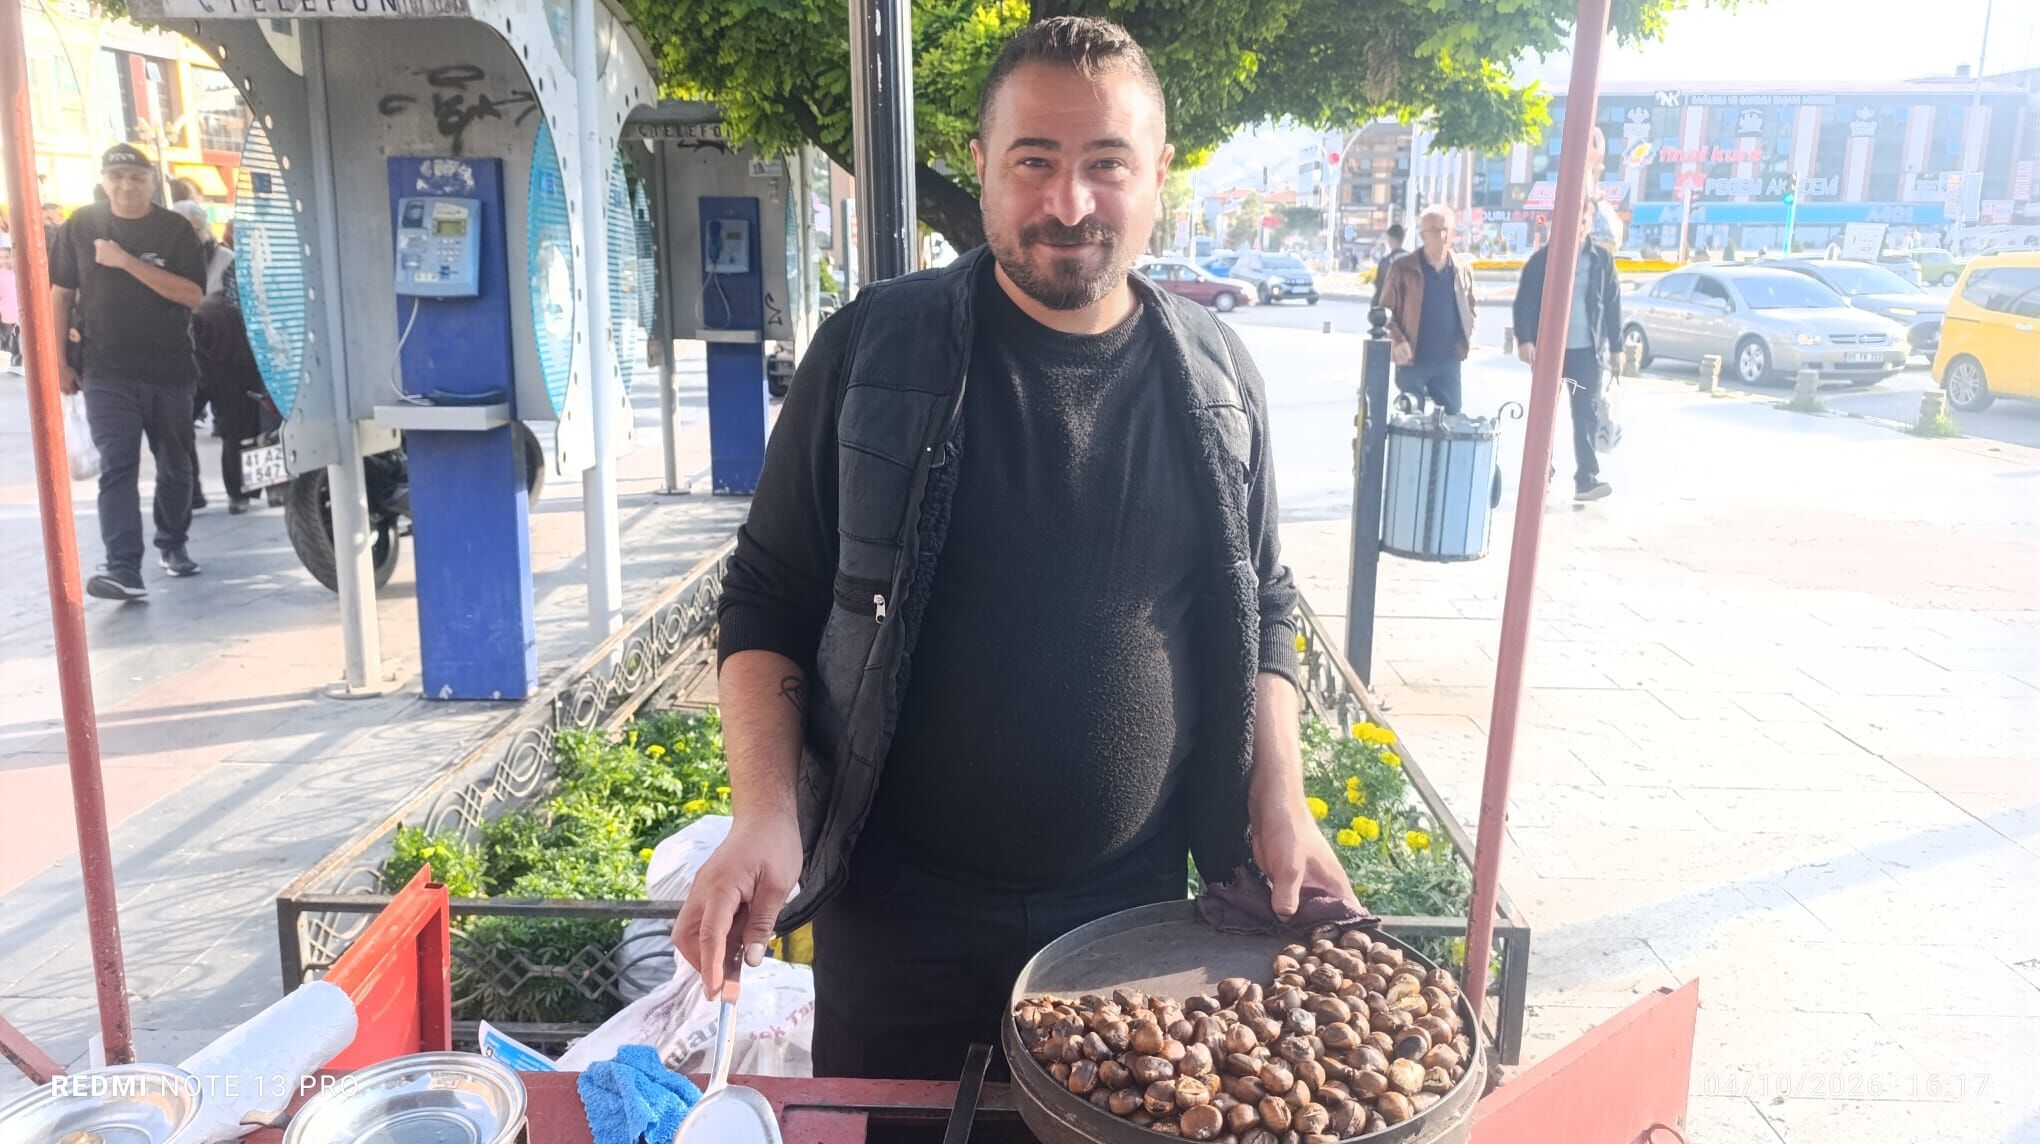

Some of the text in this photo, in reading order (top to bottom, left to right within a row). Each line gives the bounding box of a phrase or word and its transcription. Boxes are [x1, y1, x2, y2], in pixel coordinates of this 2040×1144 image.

[651, 125, 731, 138] TELEFO
[1704, 174, 1839, 197] PEGEM AKDEMİ
[245, 453, 259, 467] 41
[255, 463, 281, 481] 547
